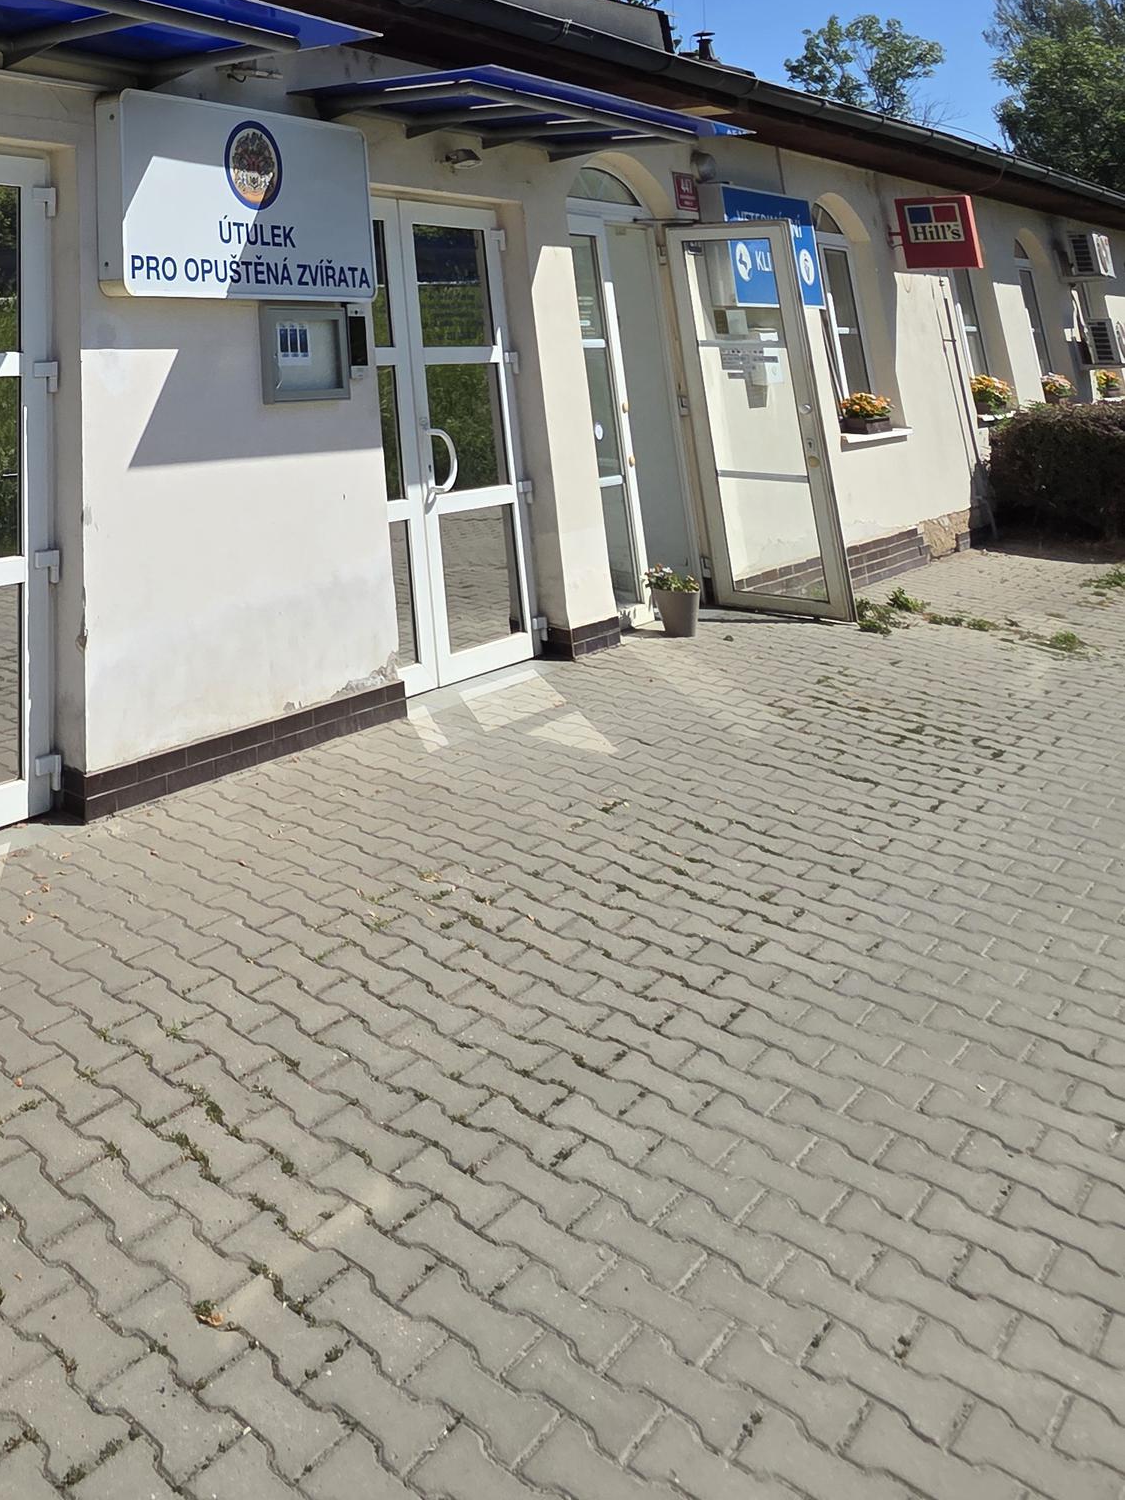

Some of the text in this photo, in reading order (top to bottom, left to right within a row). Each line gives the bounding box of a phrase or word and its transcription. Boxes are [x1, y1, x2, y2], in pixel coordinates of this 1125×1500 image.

[218, 215, 296, 248] ÚTULEK
[912, 224, 962, 241] Hill's
[131, 254, 371, 288] PRO OPUŠTĚNÁ ZVÍŘATA
